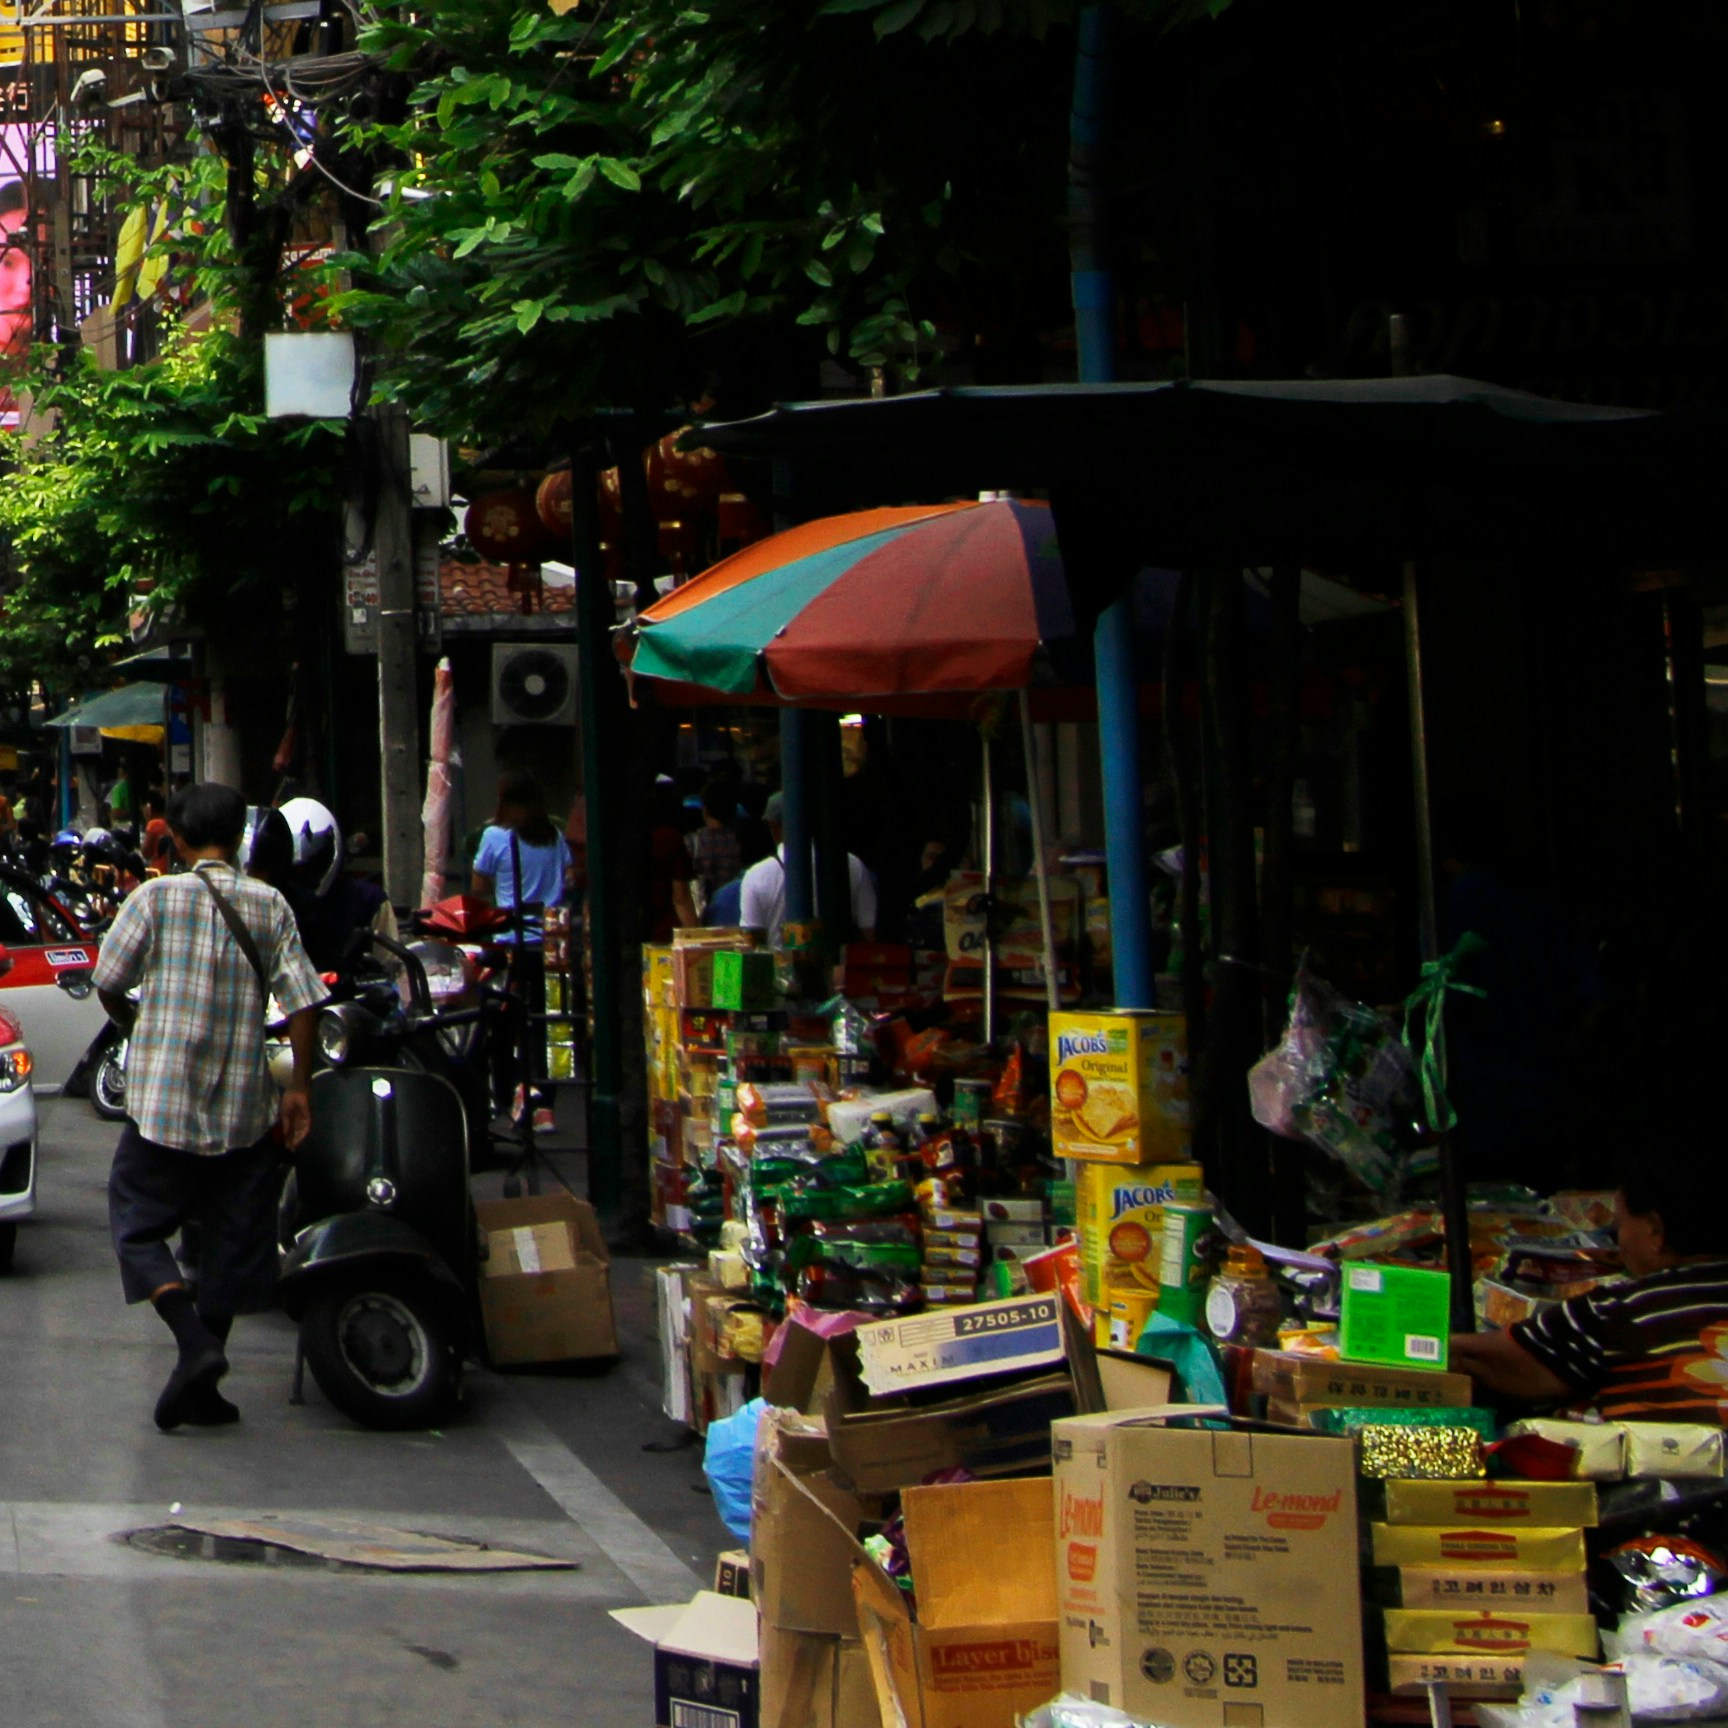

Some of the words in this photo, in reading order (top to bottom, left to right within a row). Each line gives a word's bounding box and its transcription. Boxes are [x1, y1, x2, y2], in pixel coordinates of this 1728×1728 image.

[1055, 1029, 1107, 1066] JACOB'S
[1081, 1059, 1129, 1077] Original
[1110, 1178, 1175, 1221] JACOB'S
[961, 1304, 1051, 1331] 27505-10
[889, 1353, 955, 1375] MAXIM
[1250, 1484, 1343, 1516] Le-mond
[1432, 1665, 1521, 1682] 고려인삼
